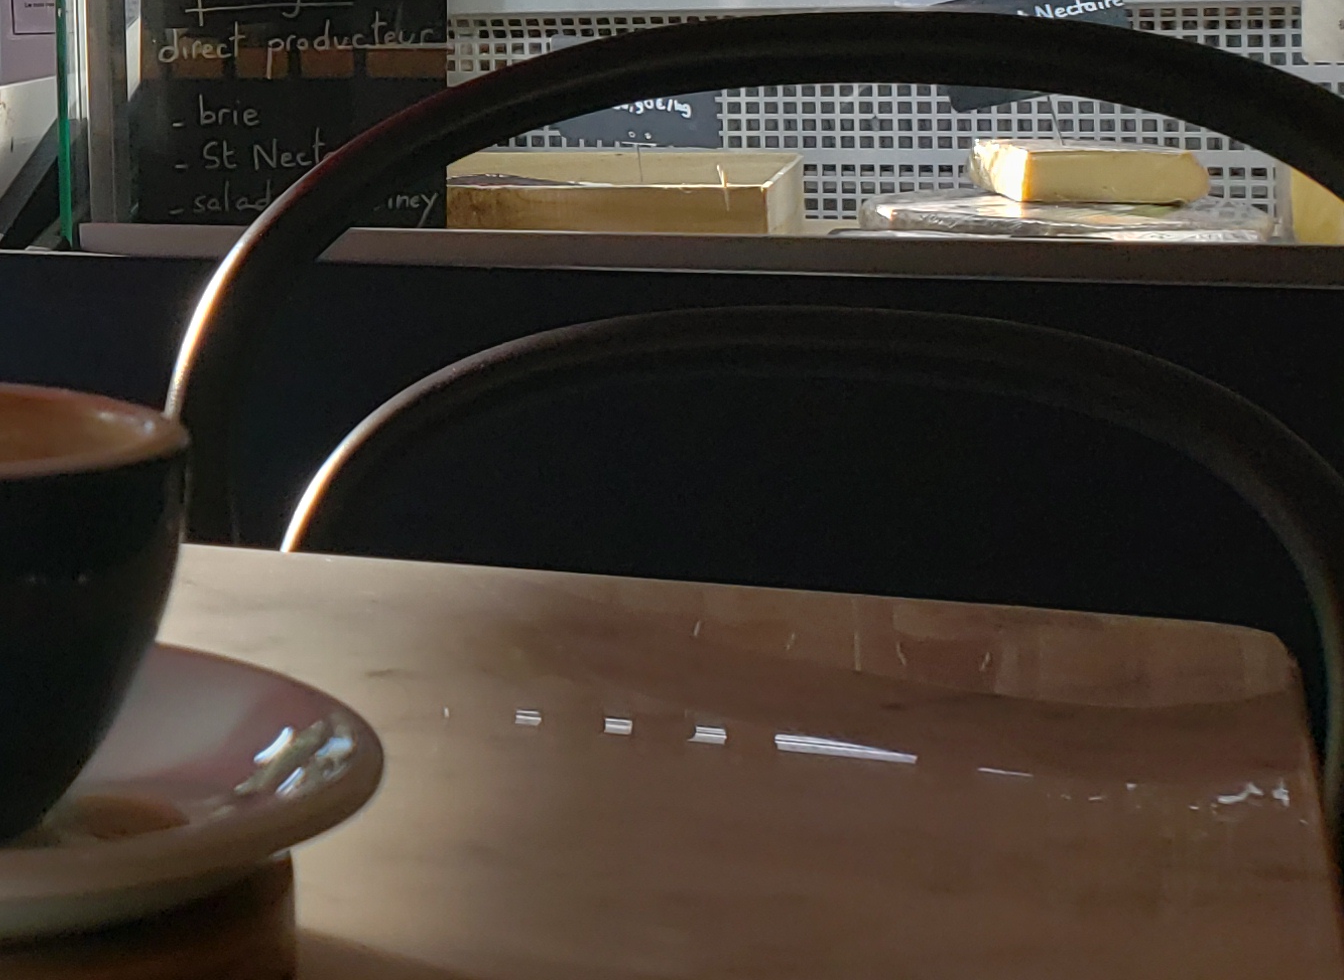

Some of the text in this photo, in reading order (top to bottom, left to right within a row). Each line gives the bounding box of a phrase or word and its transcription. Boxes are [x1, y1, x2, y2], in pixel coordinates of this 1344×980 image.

[158, 11, 435, 80] direct producteur
[199, 93, 260, 127] brie
[202, 140, 237, 170] St
[193, 180, 275, 213] salad
